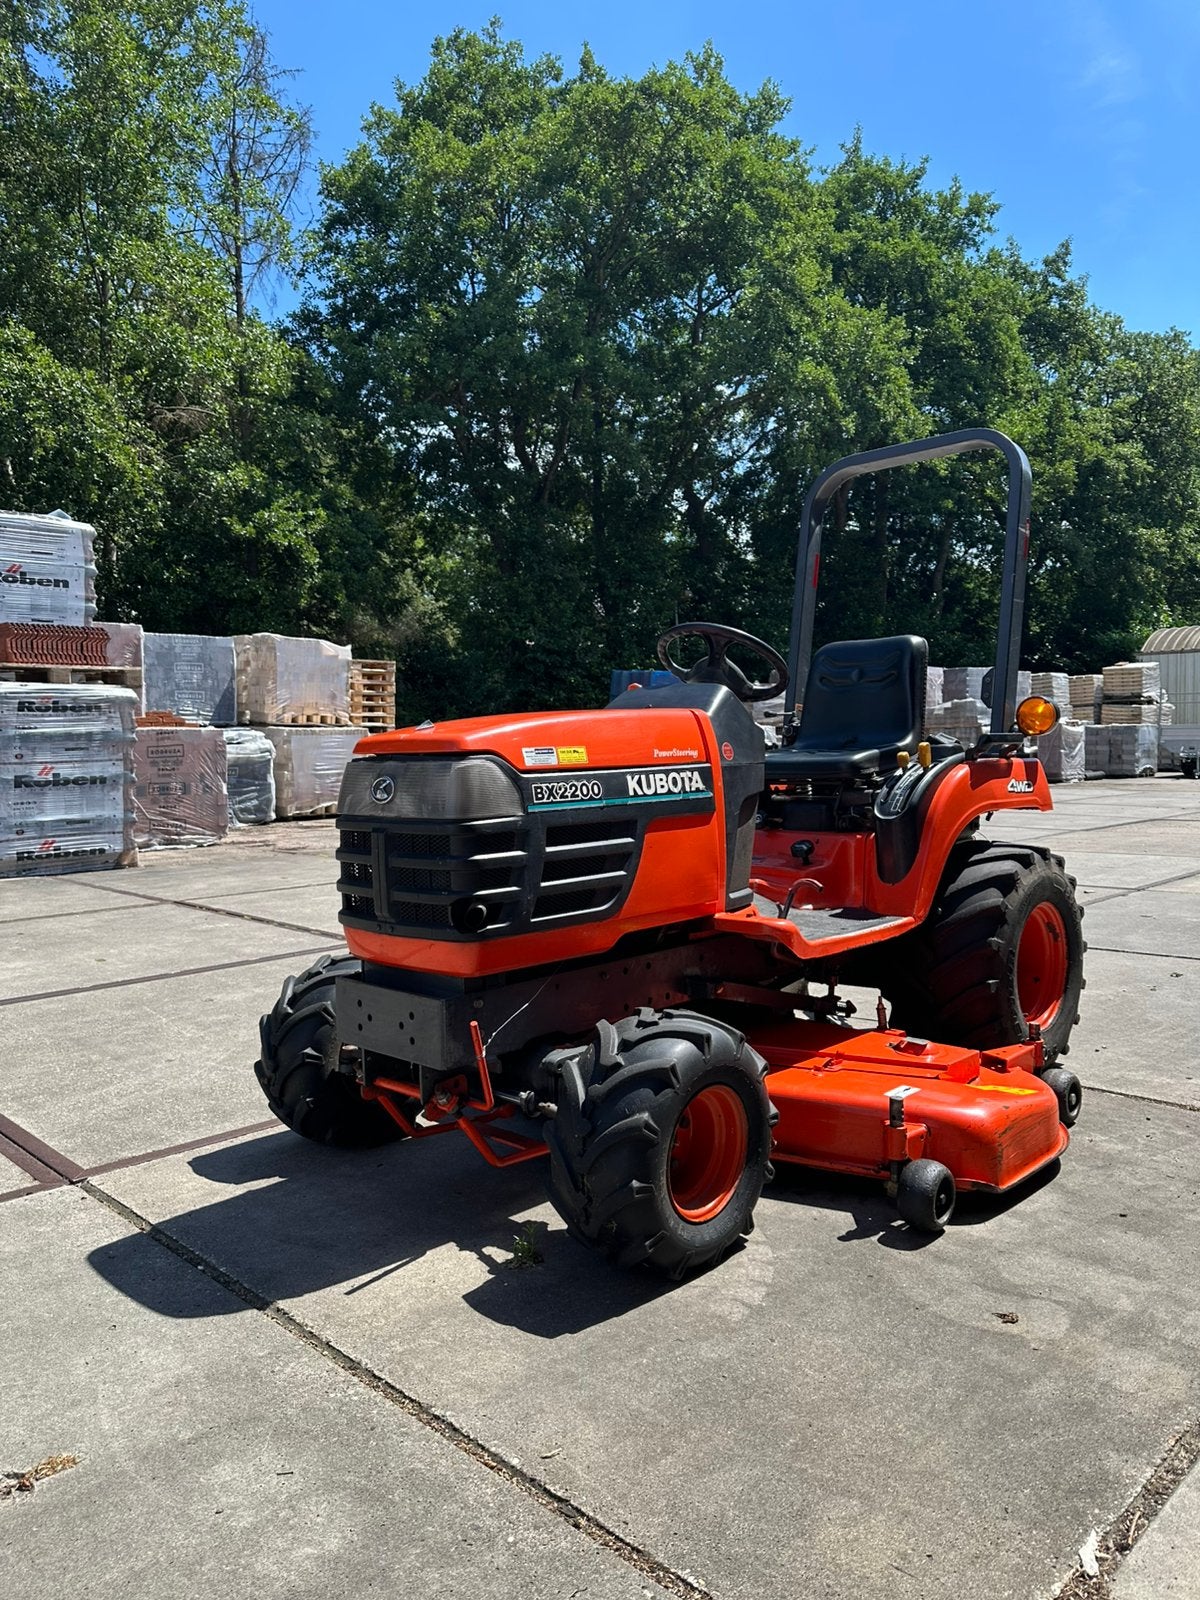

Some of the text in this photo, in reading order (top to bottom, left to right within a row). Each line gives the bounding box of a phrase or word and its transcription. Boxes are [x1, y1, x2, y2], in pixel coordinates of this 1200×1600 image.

[0, 564, 69, 588] öben
[532, 780, 603, 803] BX2200
[625, 770, 706, 796] KUBOTA
[1007, 779, 1034, 793] 4WD
